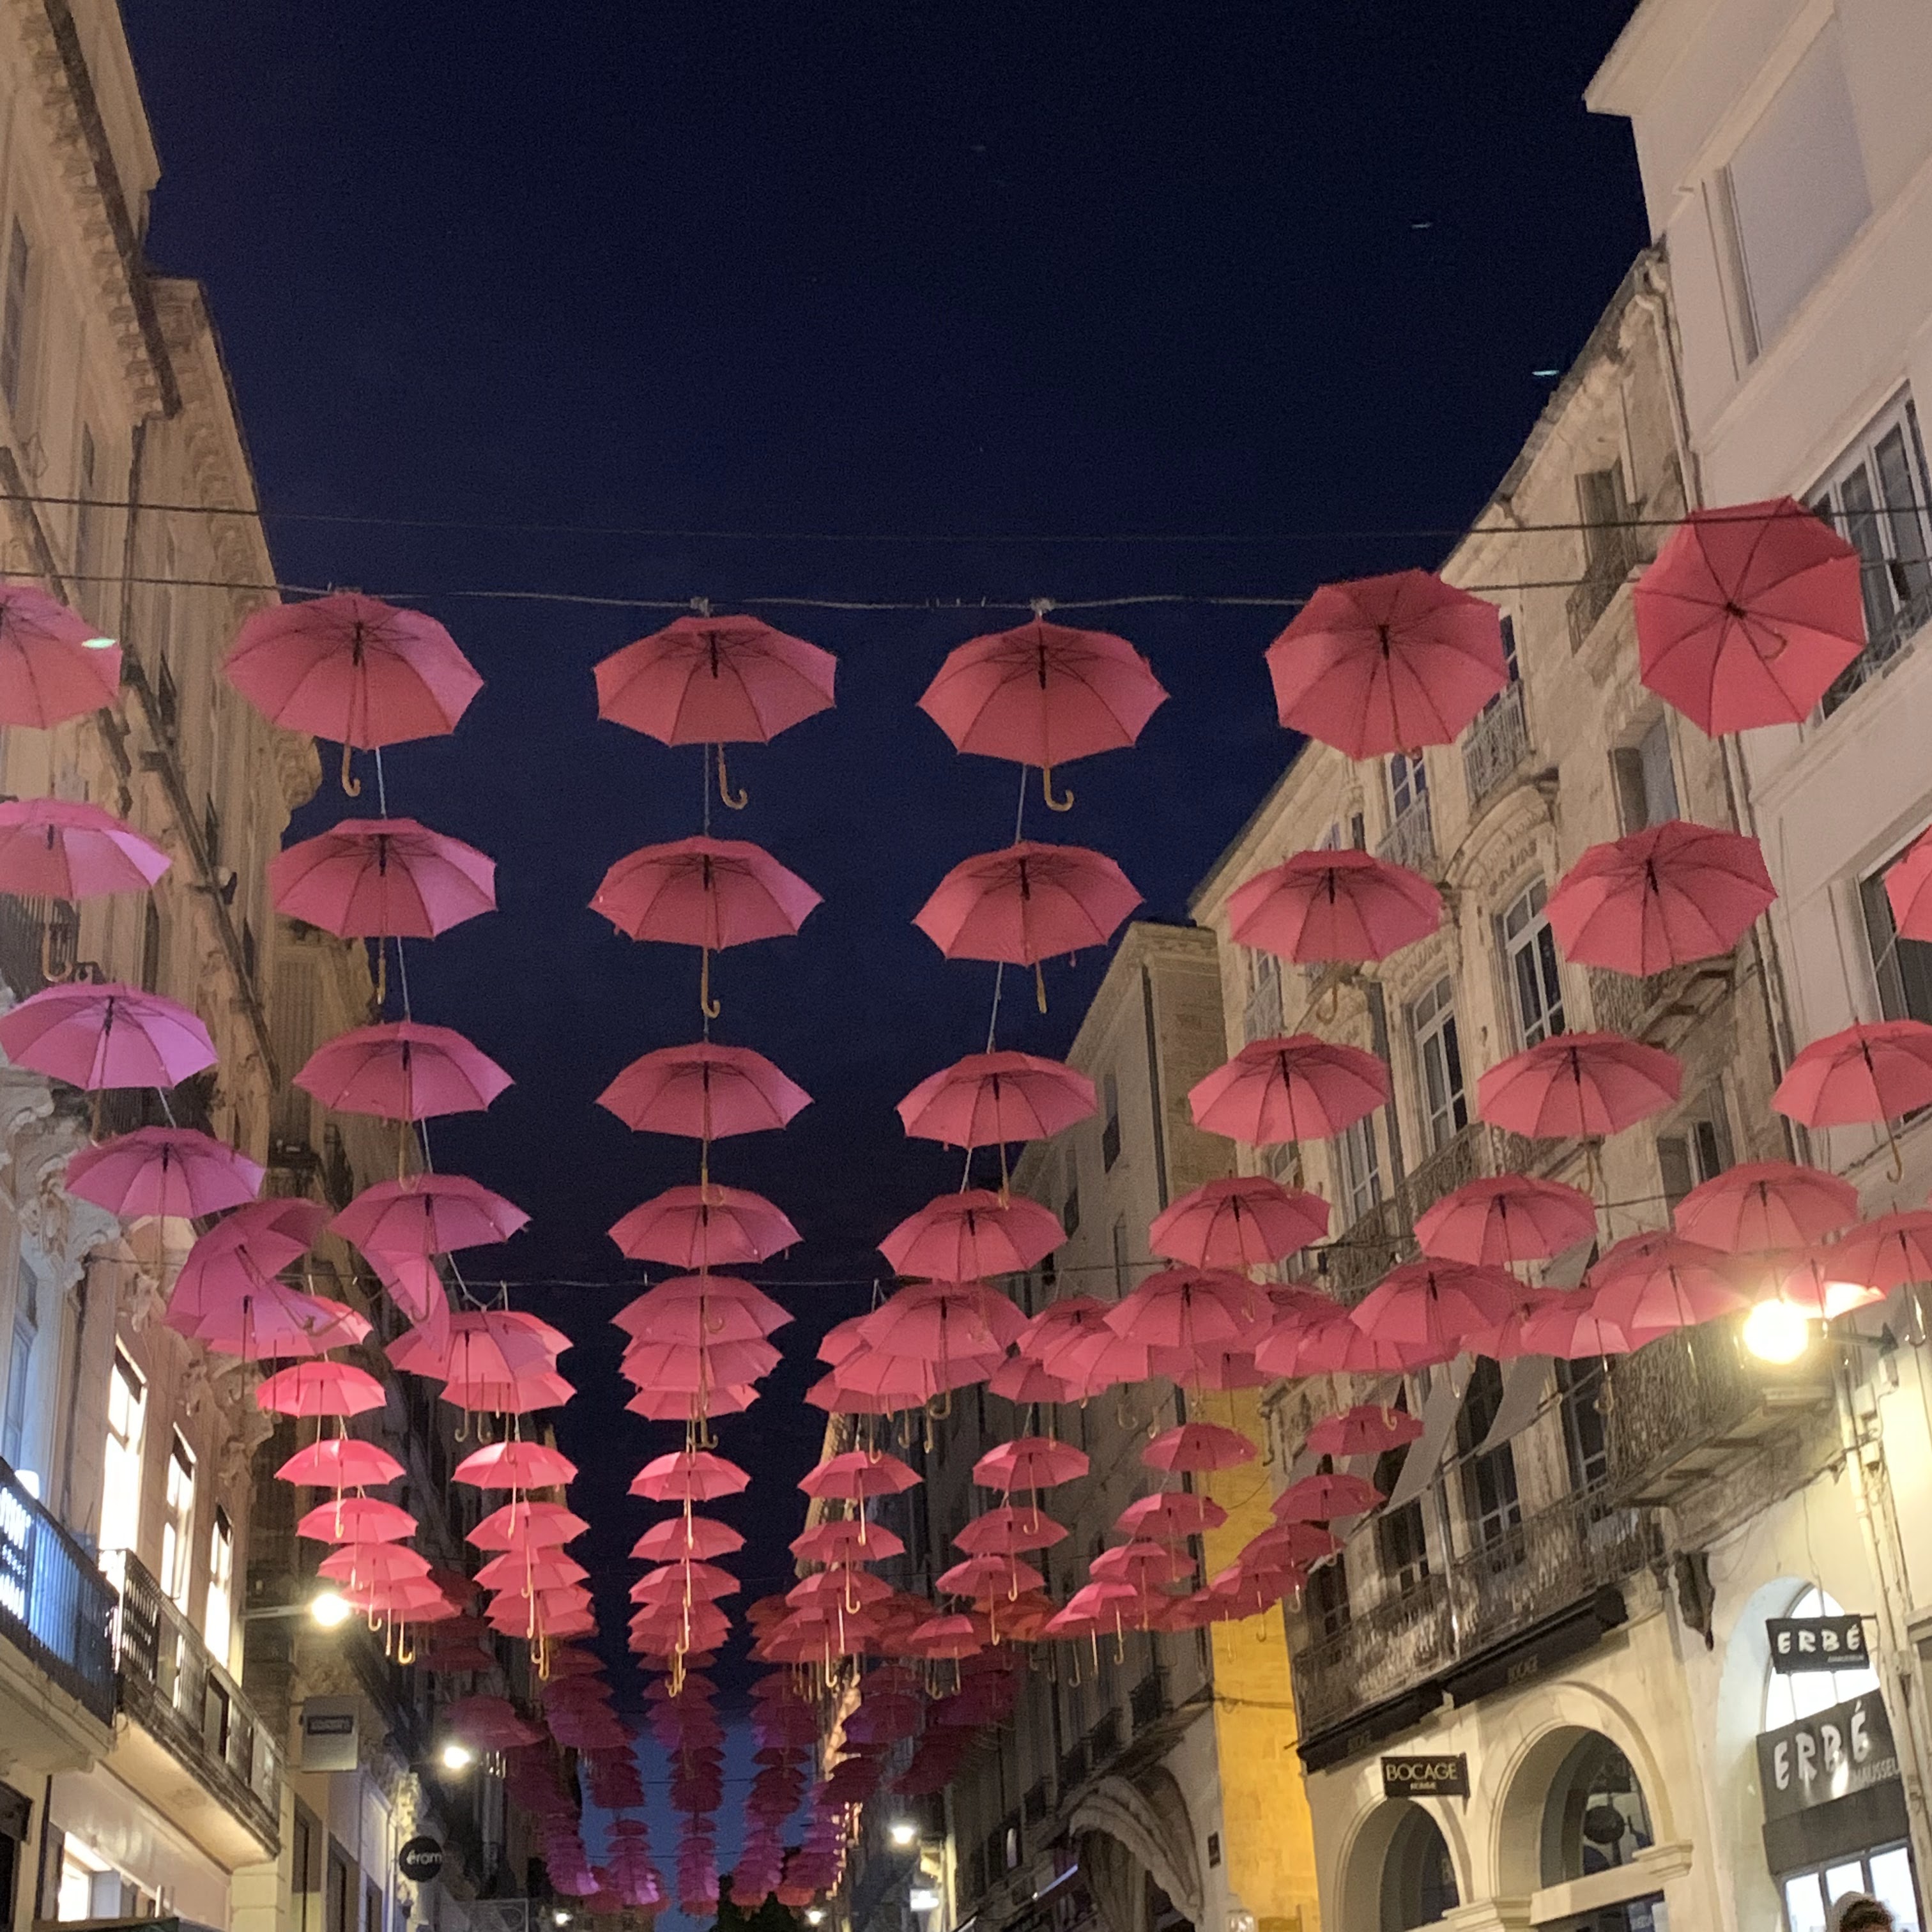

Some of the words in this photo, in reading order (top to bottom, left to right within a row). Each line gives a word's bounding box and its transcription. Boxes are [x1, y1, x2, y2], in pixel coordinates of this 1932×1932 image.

[1777, 1624, 1860, 1653] ERBÉ
[1774, 1699, 1869, 1790] ERBÉ
[1386, 1762, 1458, 1781] BOCAGE
